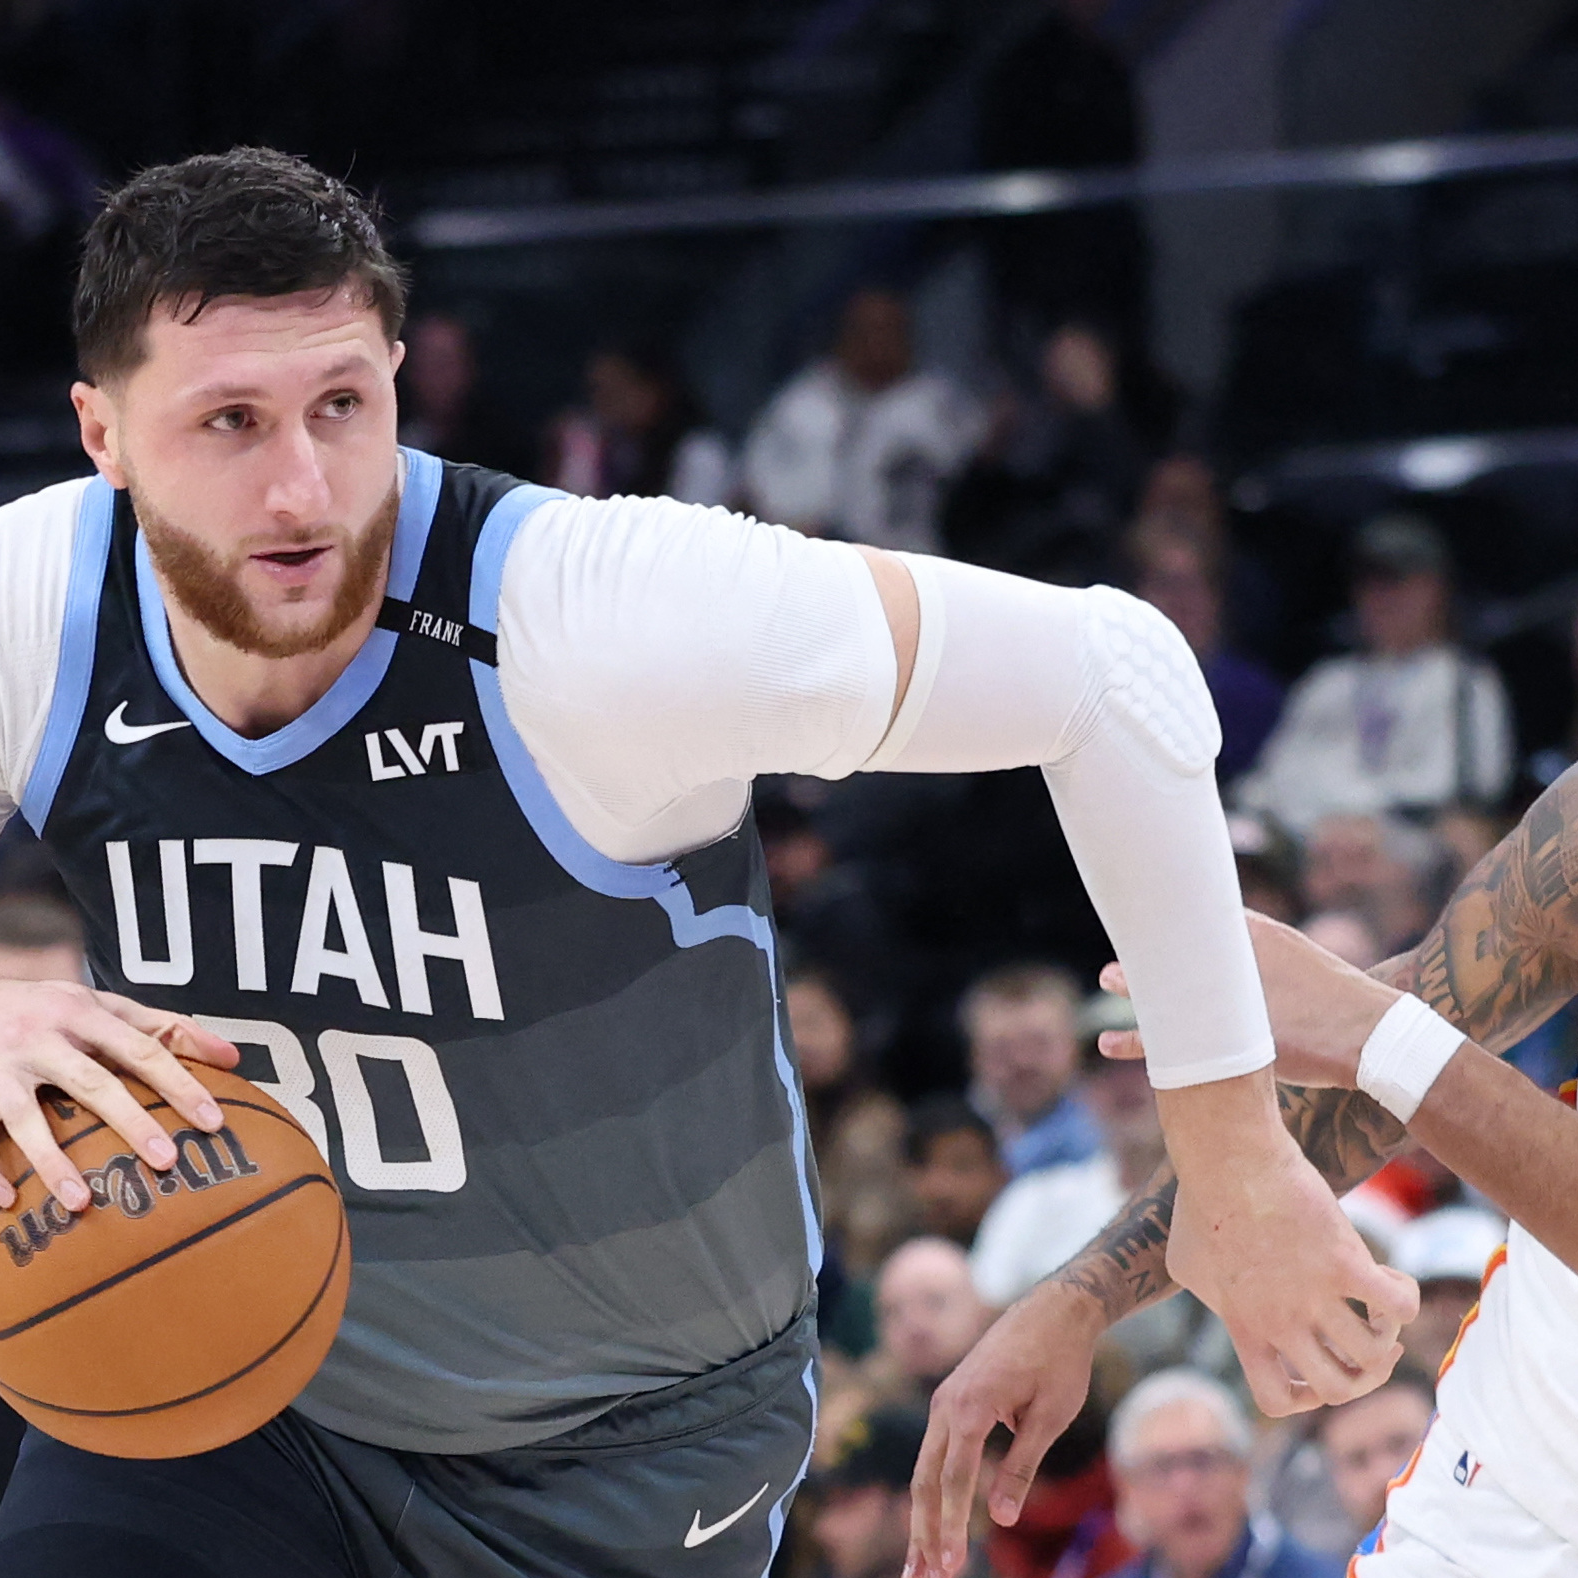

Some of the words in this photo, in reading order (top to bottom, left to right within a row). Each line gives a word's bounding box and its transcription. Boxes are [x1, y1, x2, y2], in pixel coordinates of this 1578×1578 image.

[409, 609, 465, 647] FRANK
[364, 721, 465, 782] LVT
[105, 838, 505, 1021] UTAH
